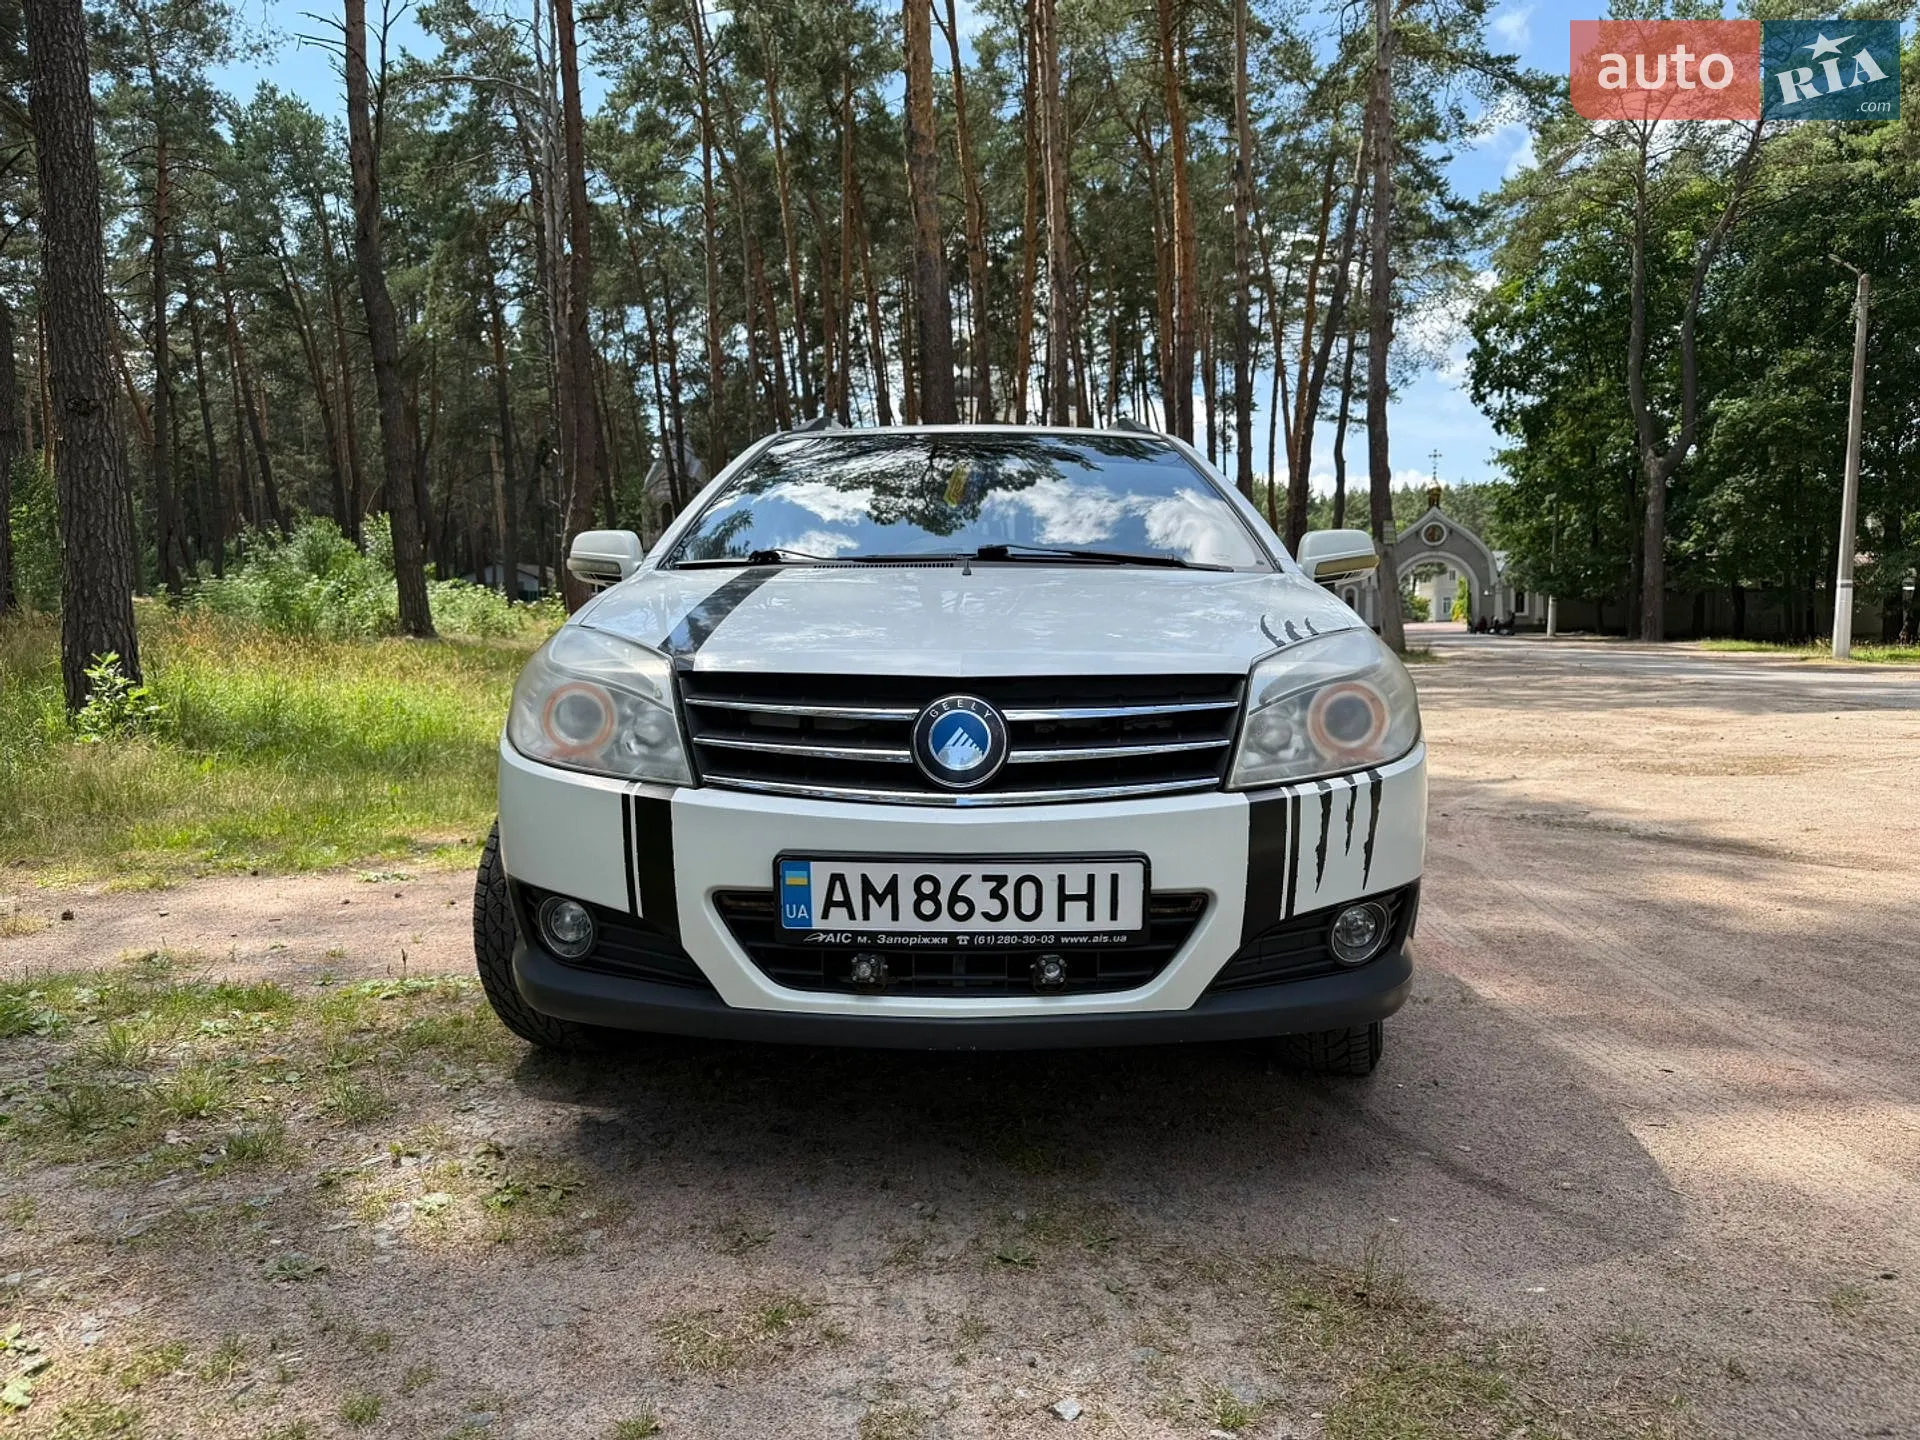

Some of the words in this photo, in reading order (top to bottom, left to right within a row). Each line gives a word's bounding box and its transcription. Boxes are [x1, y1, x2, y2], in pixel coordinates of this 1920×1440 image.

[929, 699, 992, 718] GEELY
[820, 873, 900, 922] AM
[912, 873, 1043, 923] 8630
[1056, 873, 1119, 922] HI
[785, 904, 808, 919] UA
[877, 934, 948, 946] Запоріжжя
[974, 935, 995, 945] (61)
[997, 935, 1055, 944] 280-30-03
[1060, 935, 1127, 943] www.ais.ua
